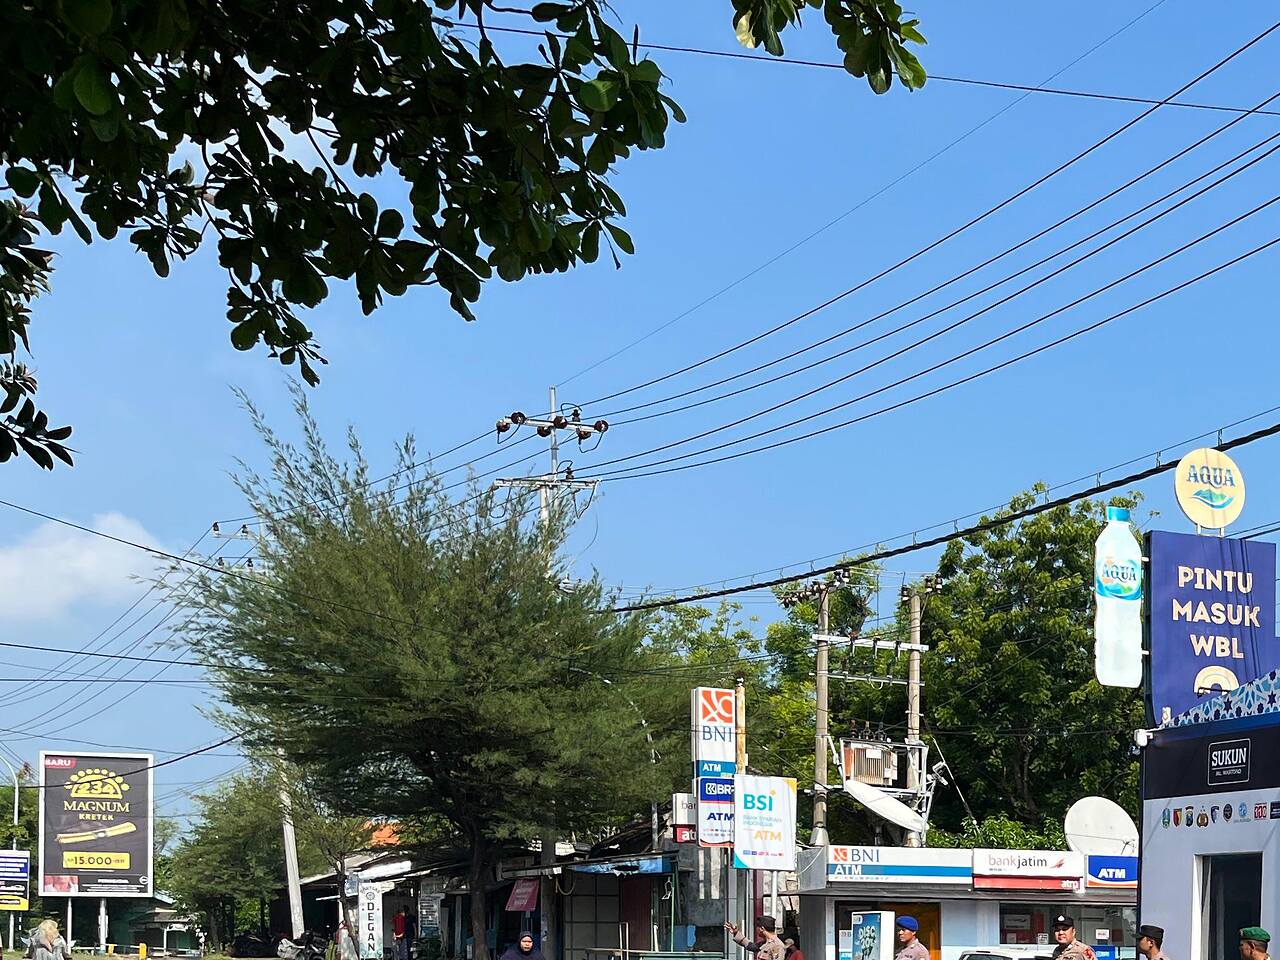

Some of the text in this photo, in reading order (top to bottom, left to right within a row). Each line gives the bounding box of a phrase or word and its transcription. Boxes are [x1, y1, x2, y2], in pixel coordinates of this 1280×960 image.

[1186, 464, 1236, 489] AQUA
[1103, 564, 1137, 582] AQUA
[1178, 565, 1253, 594] PINTU
[1172, 599, 1260, 628] MASUK
[1190, 634, 1244, 659] WBL
[702, 725, 732, 743] BNI
[45, 759, 71, 767] BARU
[1211, 747, 1247, 767] SUKUN
[702, 763, 721, 772] ATM
[77, 780, 115, 795] 234
[63, 800, 130, 813] MAGNUM
[743, 792, 773, 811] BSI
[79, 813, 114, 821] KRETEK
[753, 830, 782, 842] ATM
[851, 848, 880, 863] BNI
[834, 864, 861, 875] ATM
[1098, 868, 1126, 879] ATM
[367, 902, 375, 951] DEGAN
